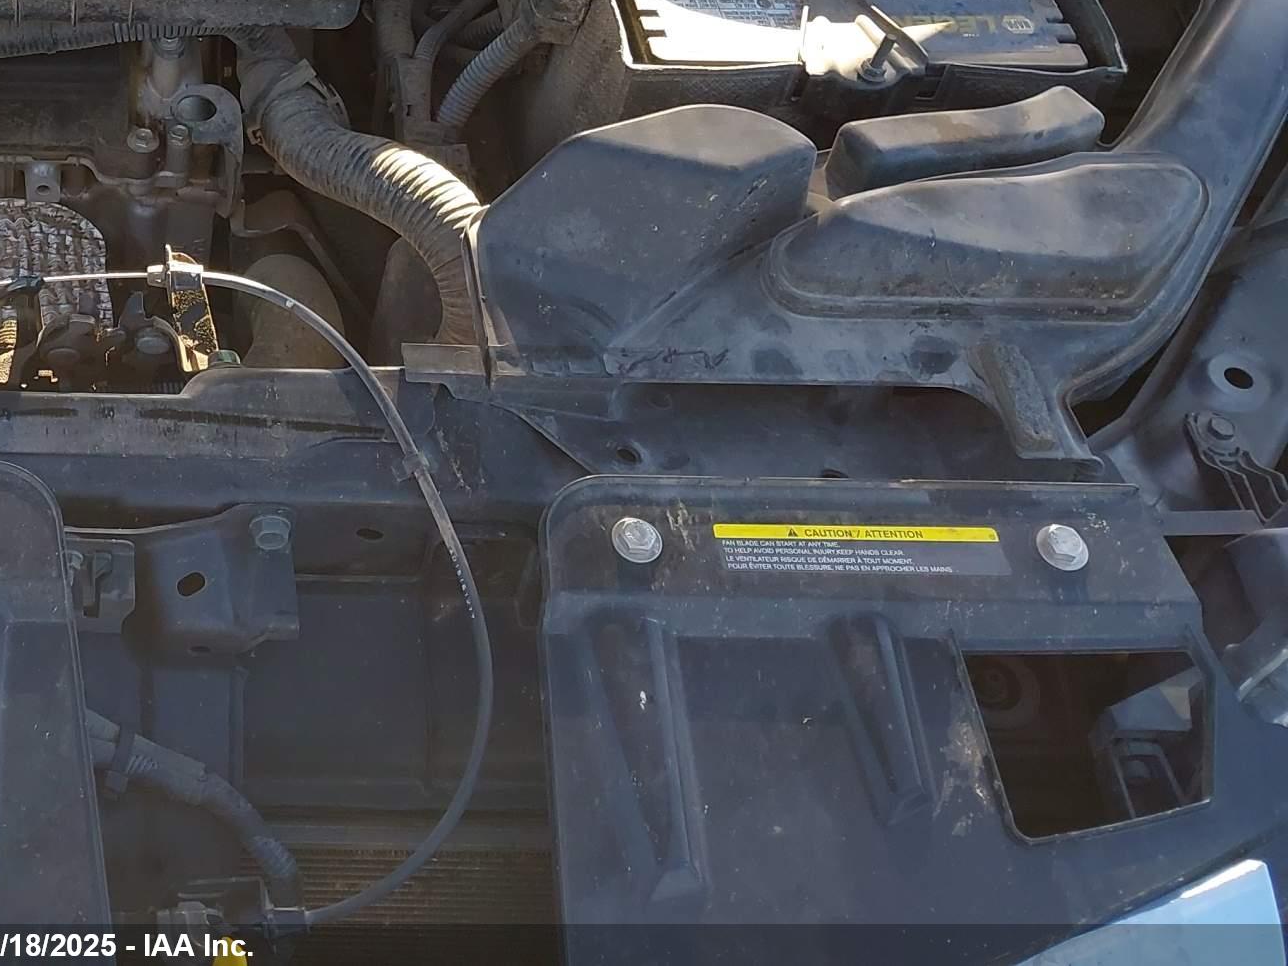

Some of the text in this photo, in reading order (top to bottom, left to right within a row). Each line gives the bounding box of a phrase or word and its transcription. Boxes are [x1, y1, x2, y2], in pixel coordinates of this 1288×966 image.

[804, 529, 924, 539] CAUTION / ATTENTION
[780, 556, 805, 564] RISQUE
